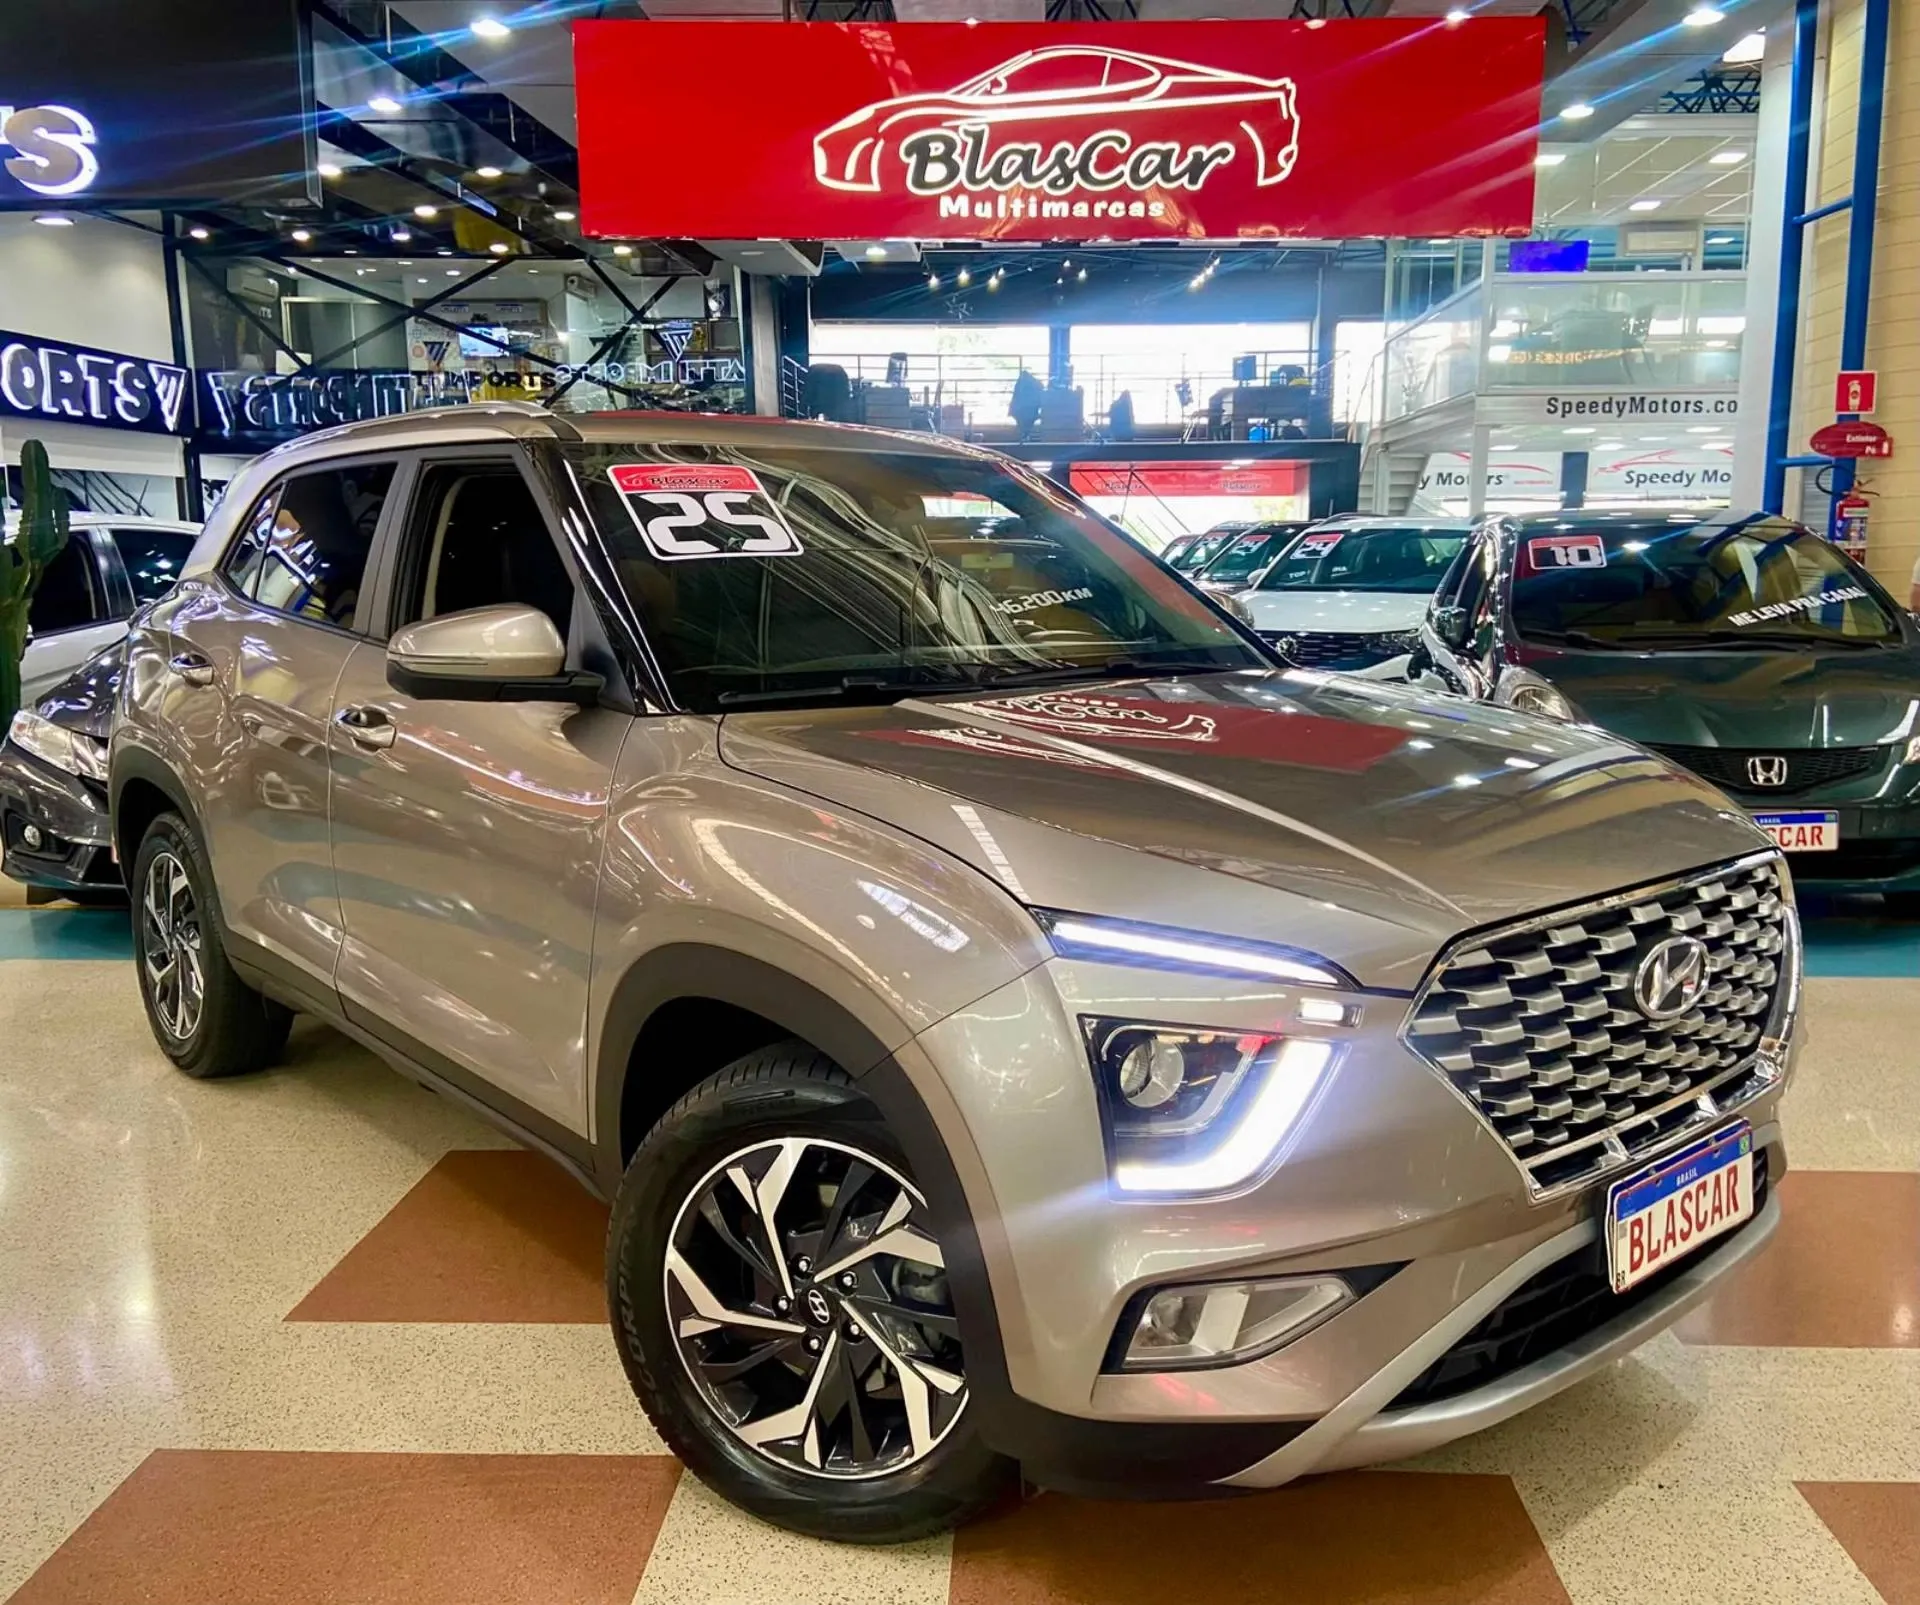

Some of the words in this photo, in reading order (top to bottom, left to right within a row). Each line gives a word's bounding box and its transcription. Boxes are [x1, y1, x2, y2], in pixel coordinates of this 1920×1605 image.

[0, 105, 98, 195] S
[900, 124, 1235, 195] BlasCar
[939, 195, 1165, 219] Multimarcas
[1546, 396, 1738, 418] SpeedyMotors.co
[1436, 472, 1503, 486] Mors
[1625, 470, 1696, 487] Speedy
[1702, 470, 1732, 484] Mo
[639, 493, 792, 555] 25
[1550, 546, 1601, 566] 10
[1728, 611, 1758, 627] ME
[1752, 603, 1796, 621] LEVA
[1789, 596, 1826, 611] PRA
[1676, 1167, 1698, 1186] BRASIL
[1630, 1164, 1739, 1273] BLASCAR
